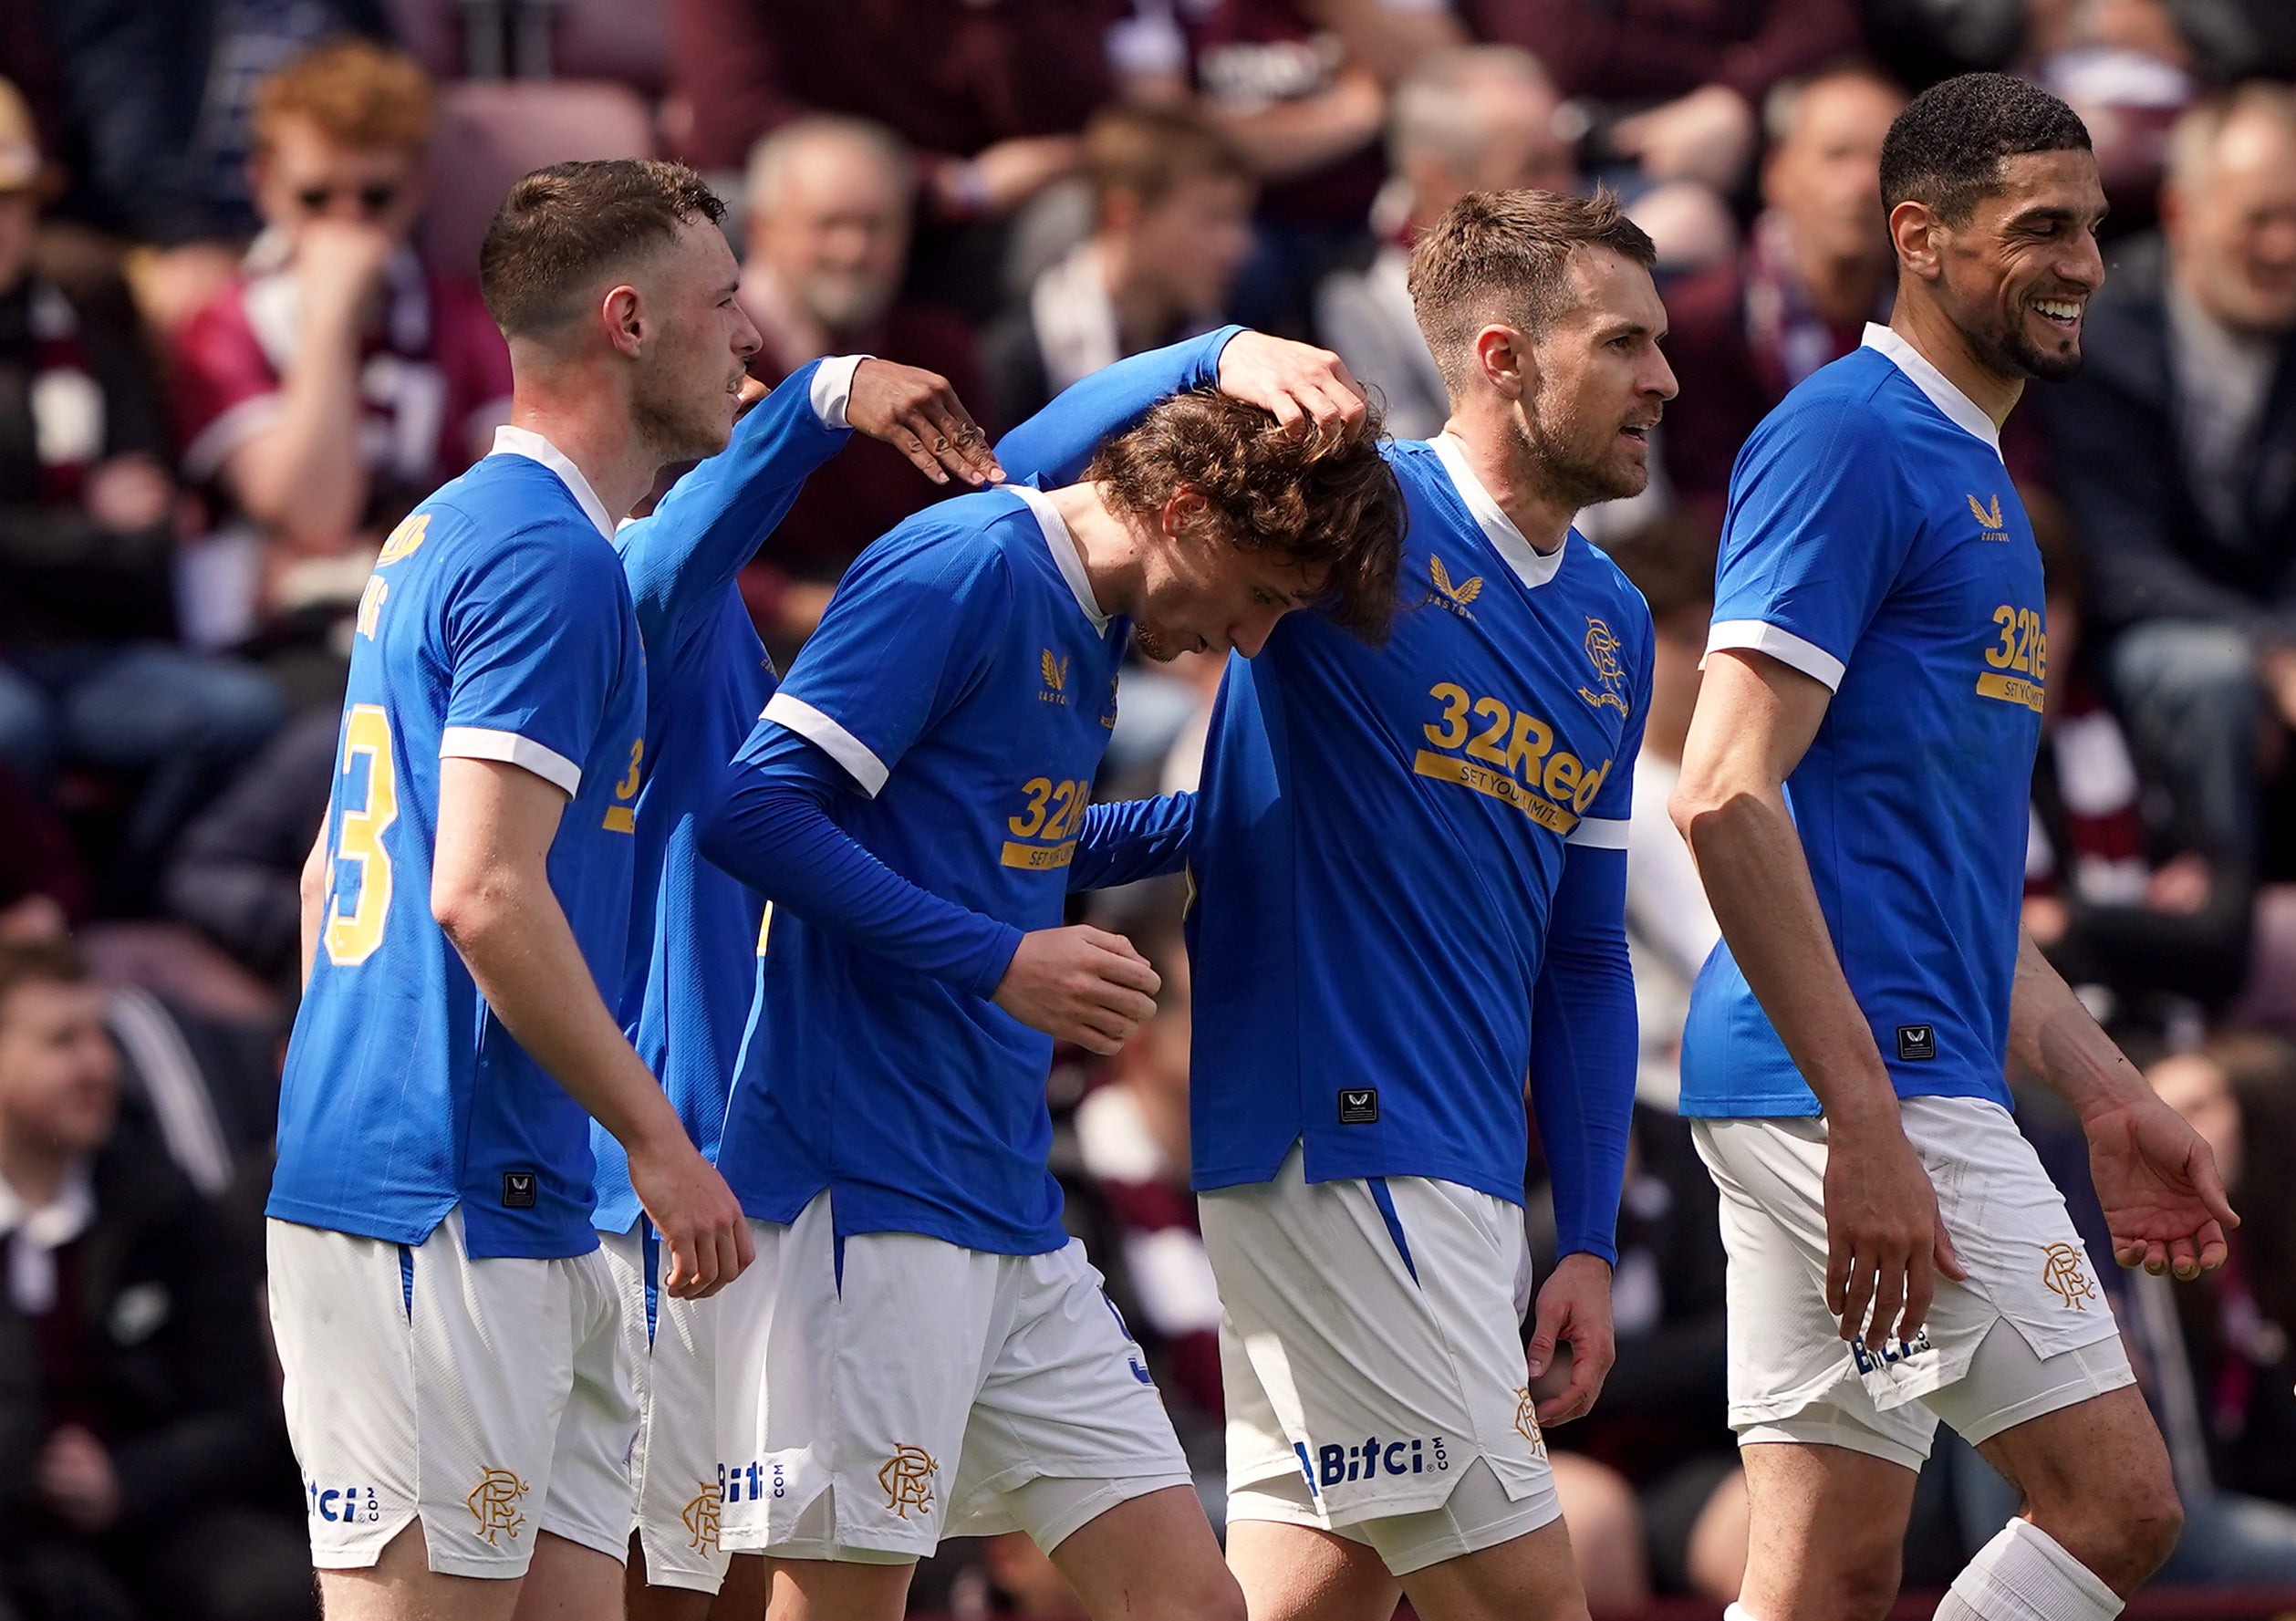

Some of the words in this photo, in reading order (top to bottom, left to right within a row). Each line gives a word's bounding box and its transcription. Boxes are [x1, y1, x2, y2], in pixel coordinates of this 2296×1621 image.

[1984, 604, 2047, 681] 32Re
[1421, 681, 1614, 814] 32Red
[1009, 776, 1089, 839] 32R
[1460, 765, 1488, 787] SET
[1490, 775, 1525, 805] YOU
[325, 703, 399, 966] 3
[1917, 1330, 1931, 1350] CO
[774, 1464, 784, 1499] COM
